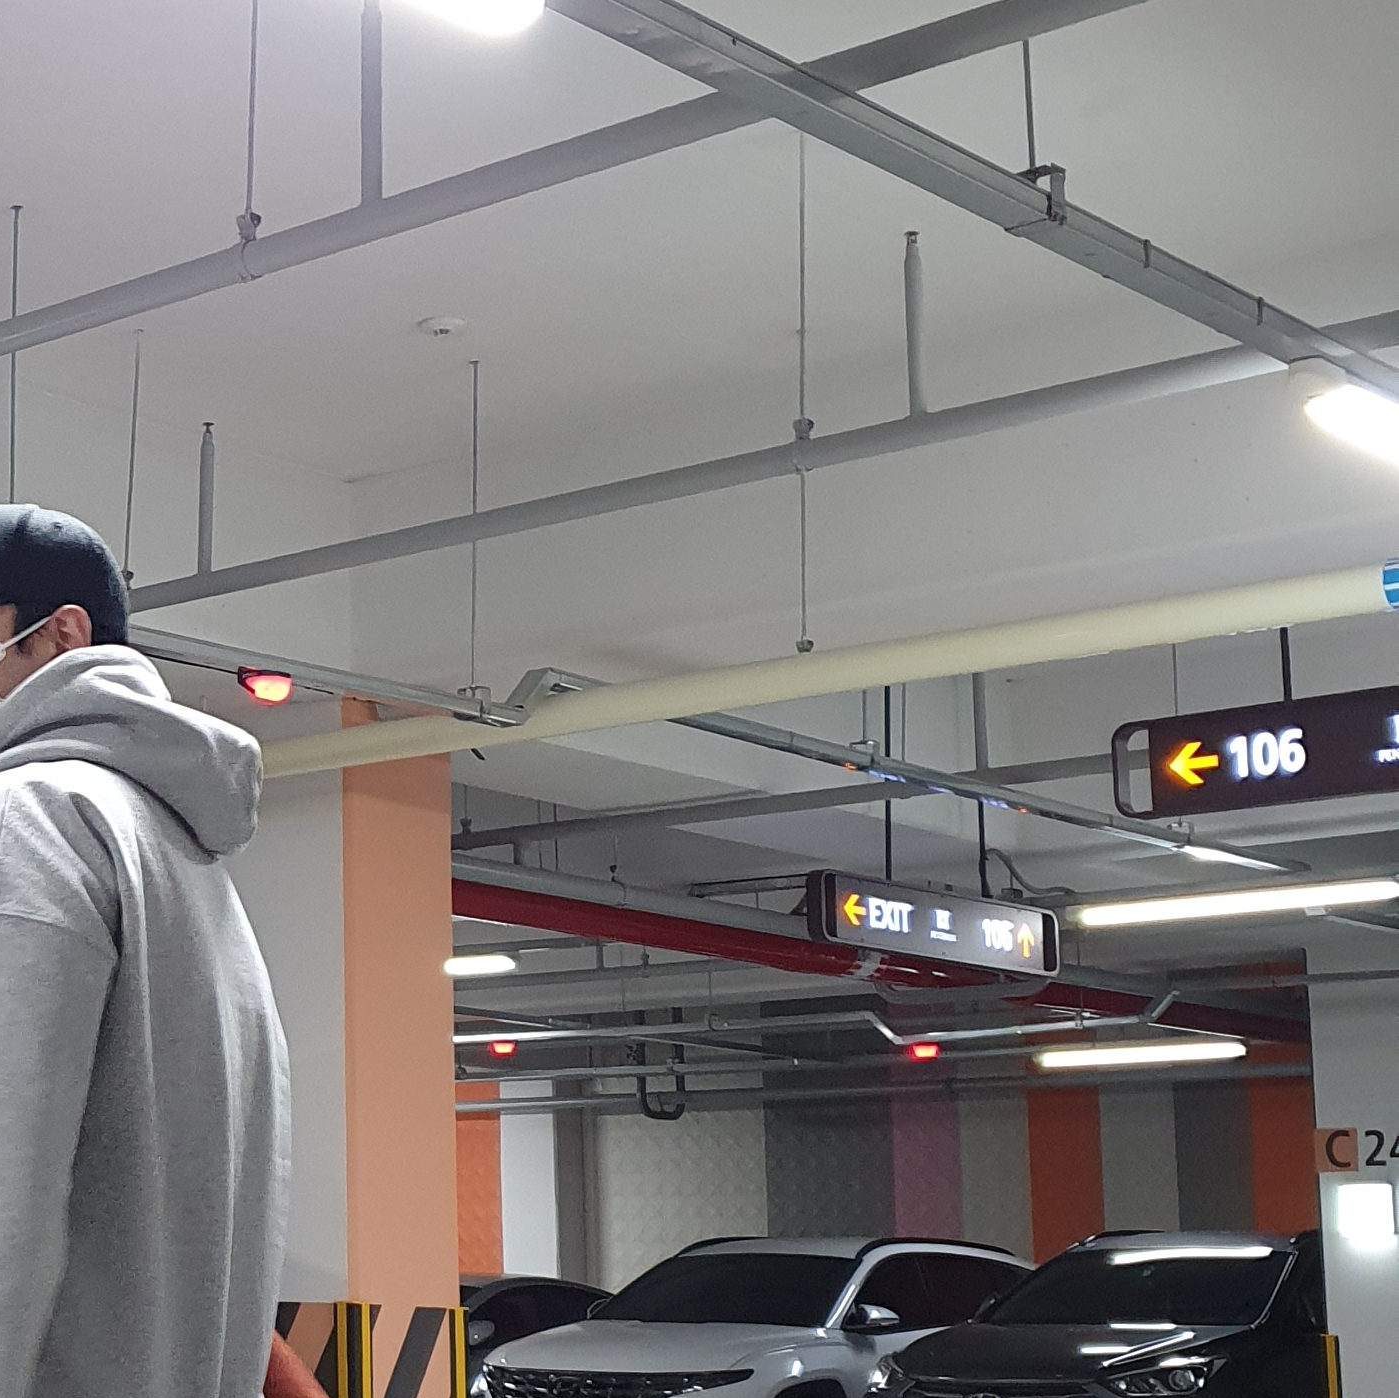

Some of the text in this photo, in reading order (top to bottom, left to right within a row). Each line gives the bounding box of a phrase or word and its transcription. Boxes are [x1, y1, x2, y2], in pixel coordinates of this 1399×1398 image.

[1227, 727, 1307, 780] 106
[866, 896, 914, 934] EXIT
[1325, 1129, 1351, 1168] C
